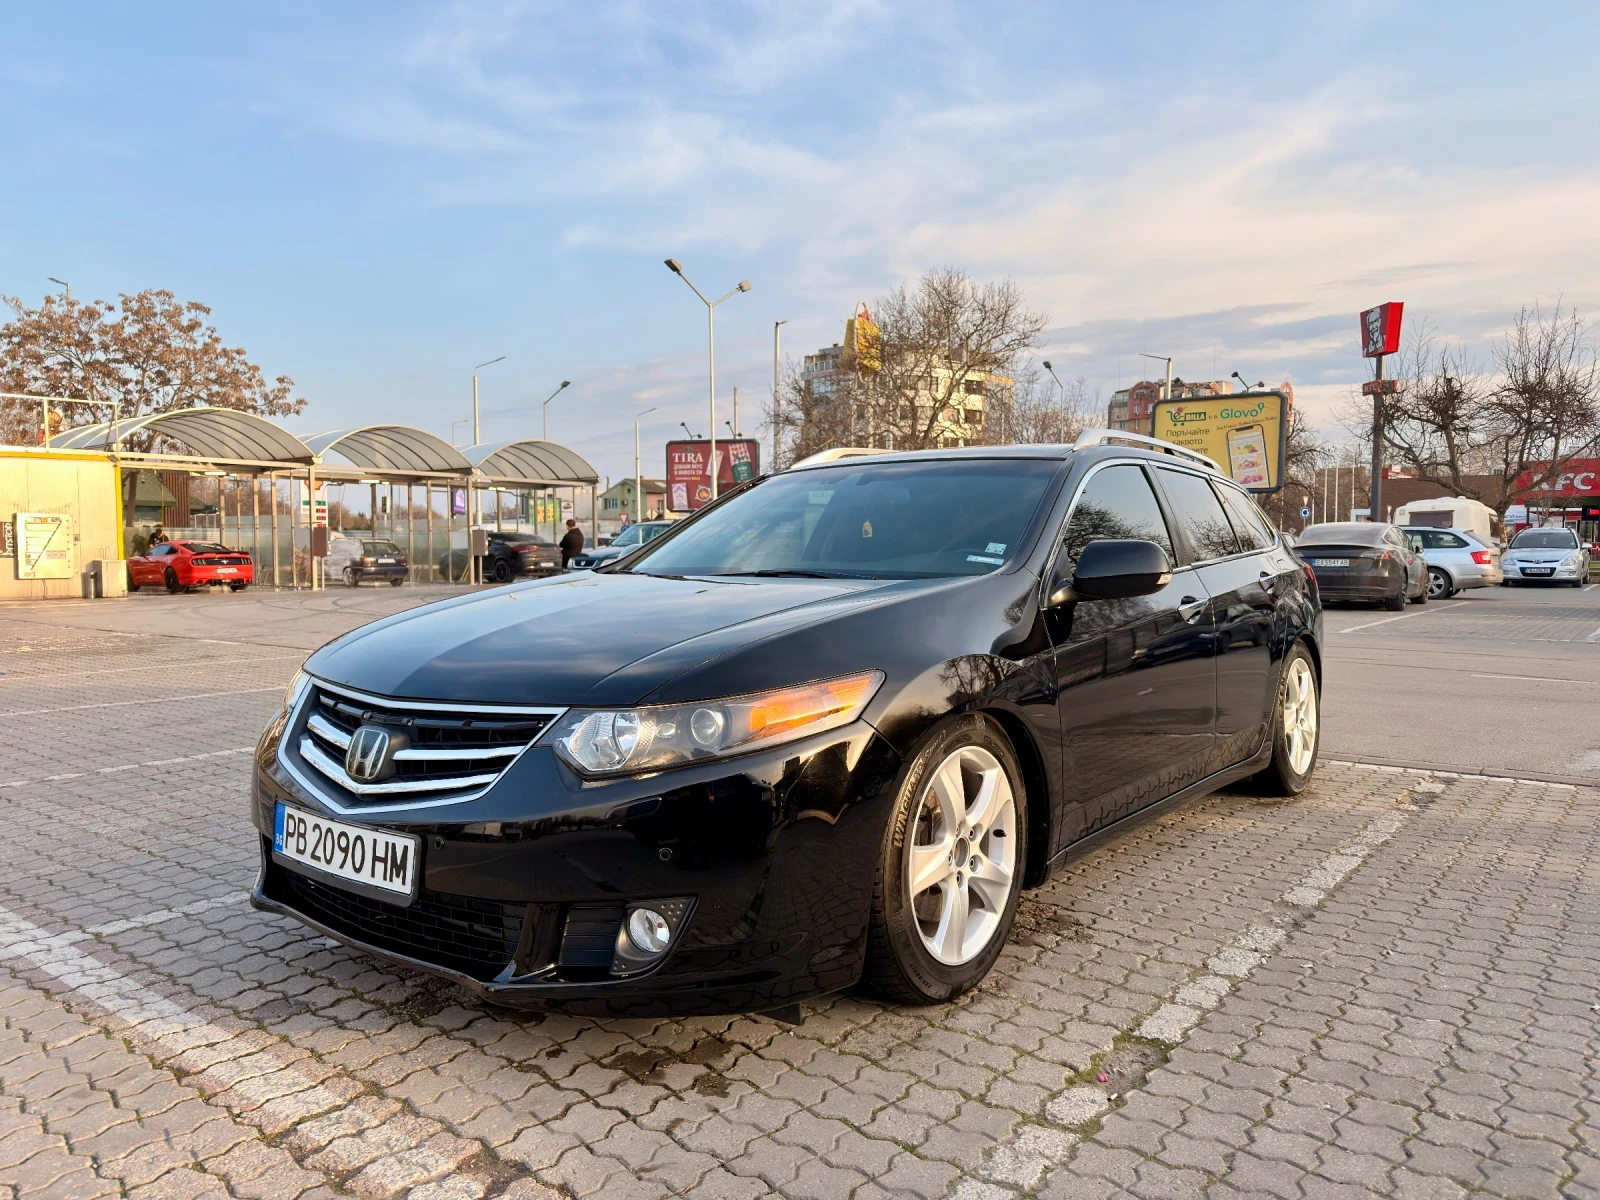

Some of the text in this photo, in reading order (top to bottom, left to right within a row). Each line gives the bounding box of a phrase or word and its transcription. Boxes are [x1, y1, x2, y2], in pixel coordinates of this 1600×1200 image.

[1220, 408, 1259, 419] Glovo
[1166, 427, 1210, 438] Поръчайте
[673, 453, 703, 463] TIRA
[1531, 472, 1596, 491] KFC
[285, 812, 409, 886] PB 2090 HM
